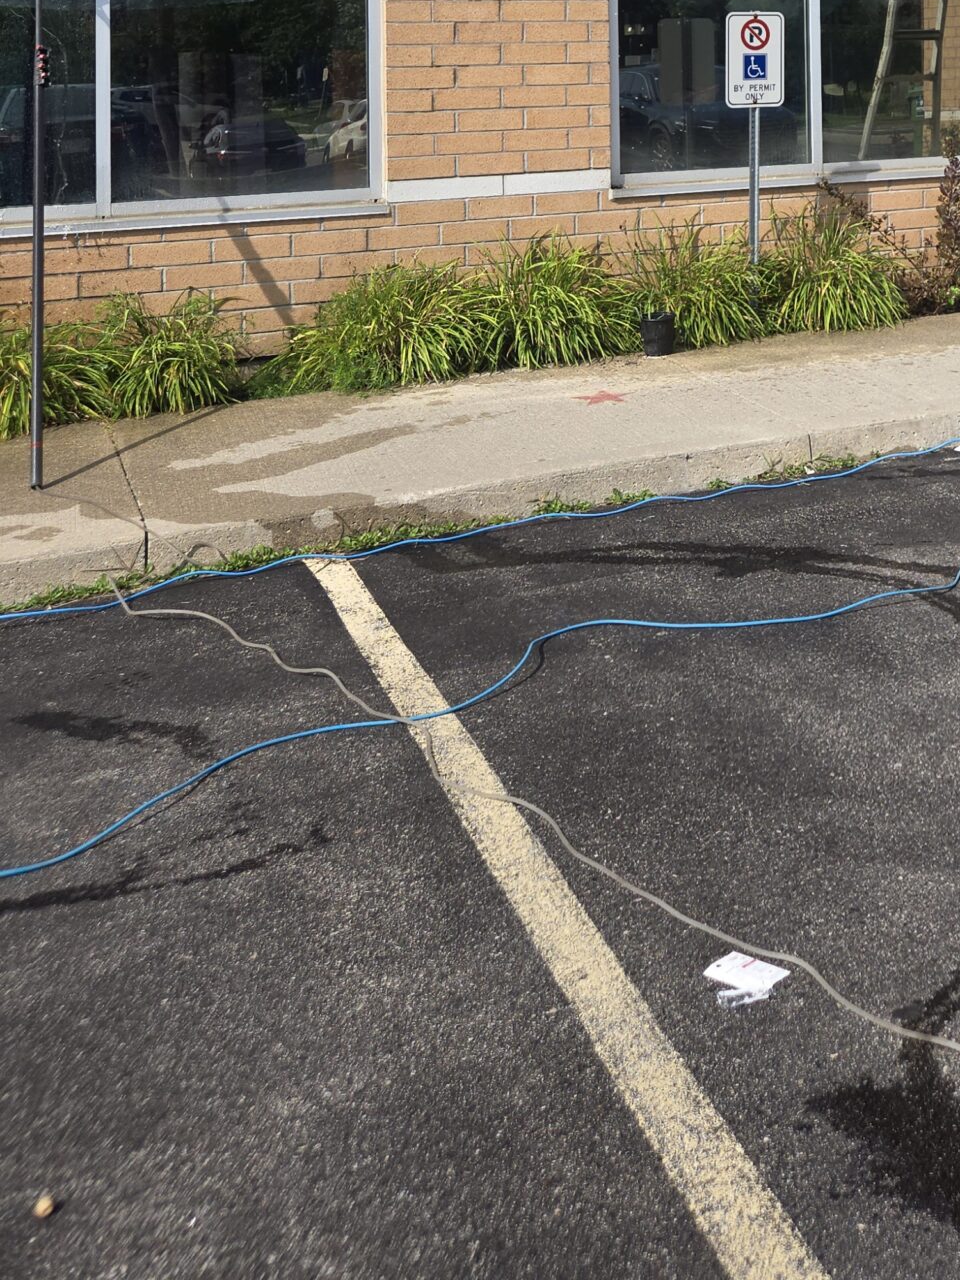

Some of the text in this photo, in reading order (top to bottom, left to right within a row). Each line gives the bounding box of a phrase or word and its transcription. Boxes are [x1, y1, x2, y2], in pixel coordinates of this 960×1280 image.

[733, 83, 776, 92] BY PERMIT
[745, 93, 764, 101] ONLY
